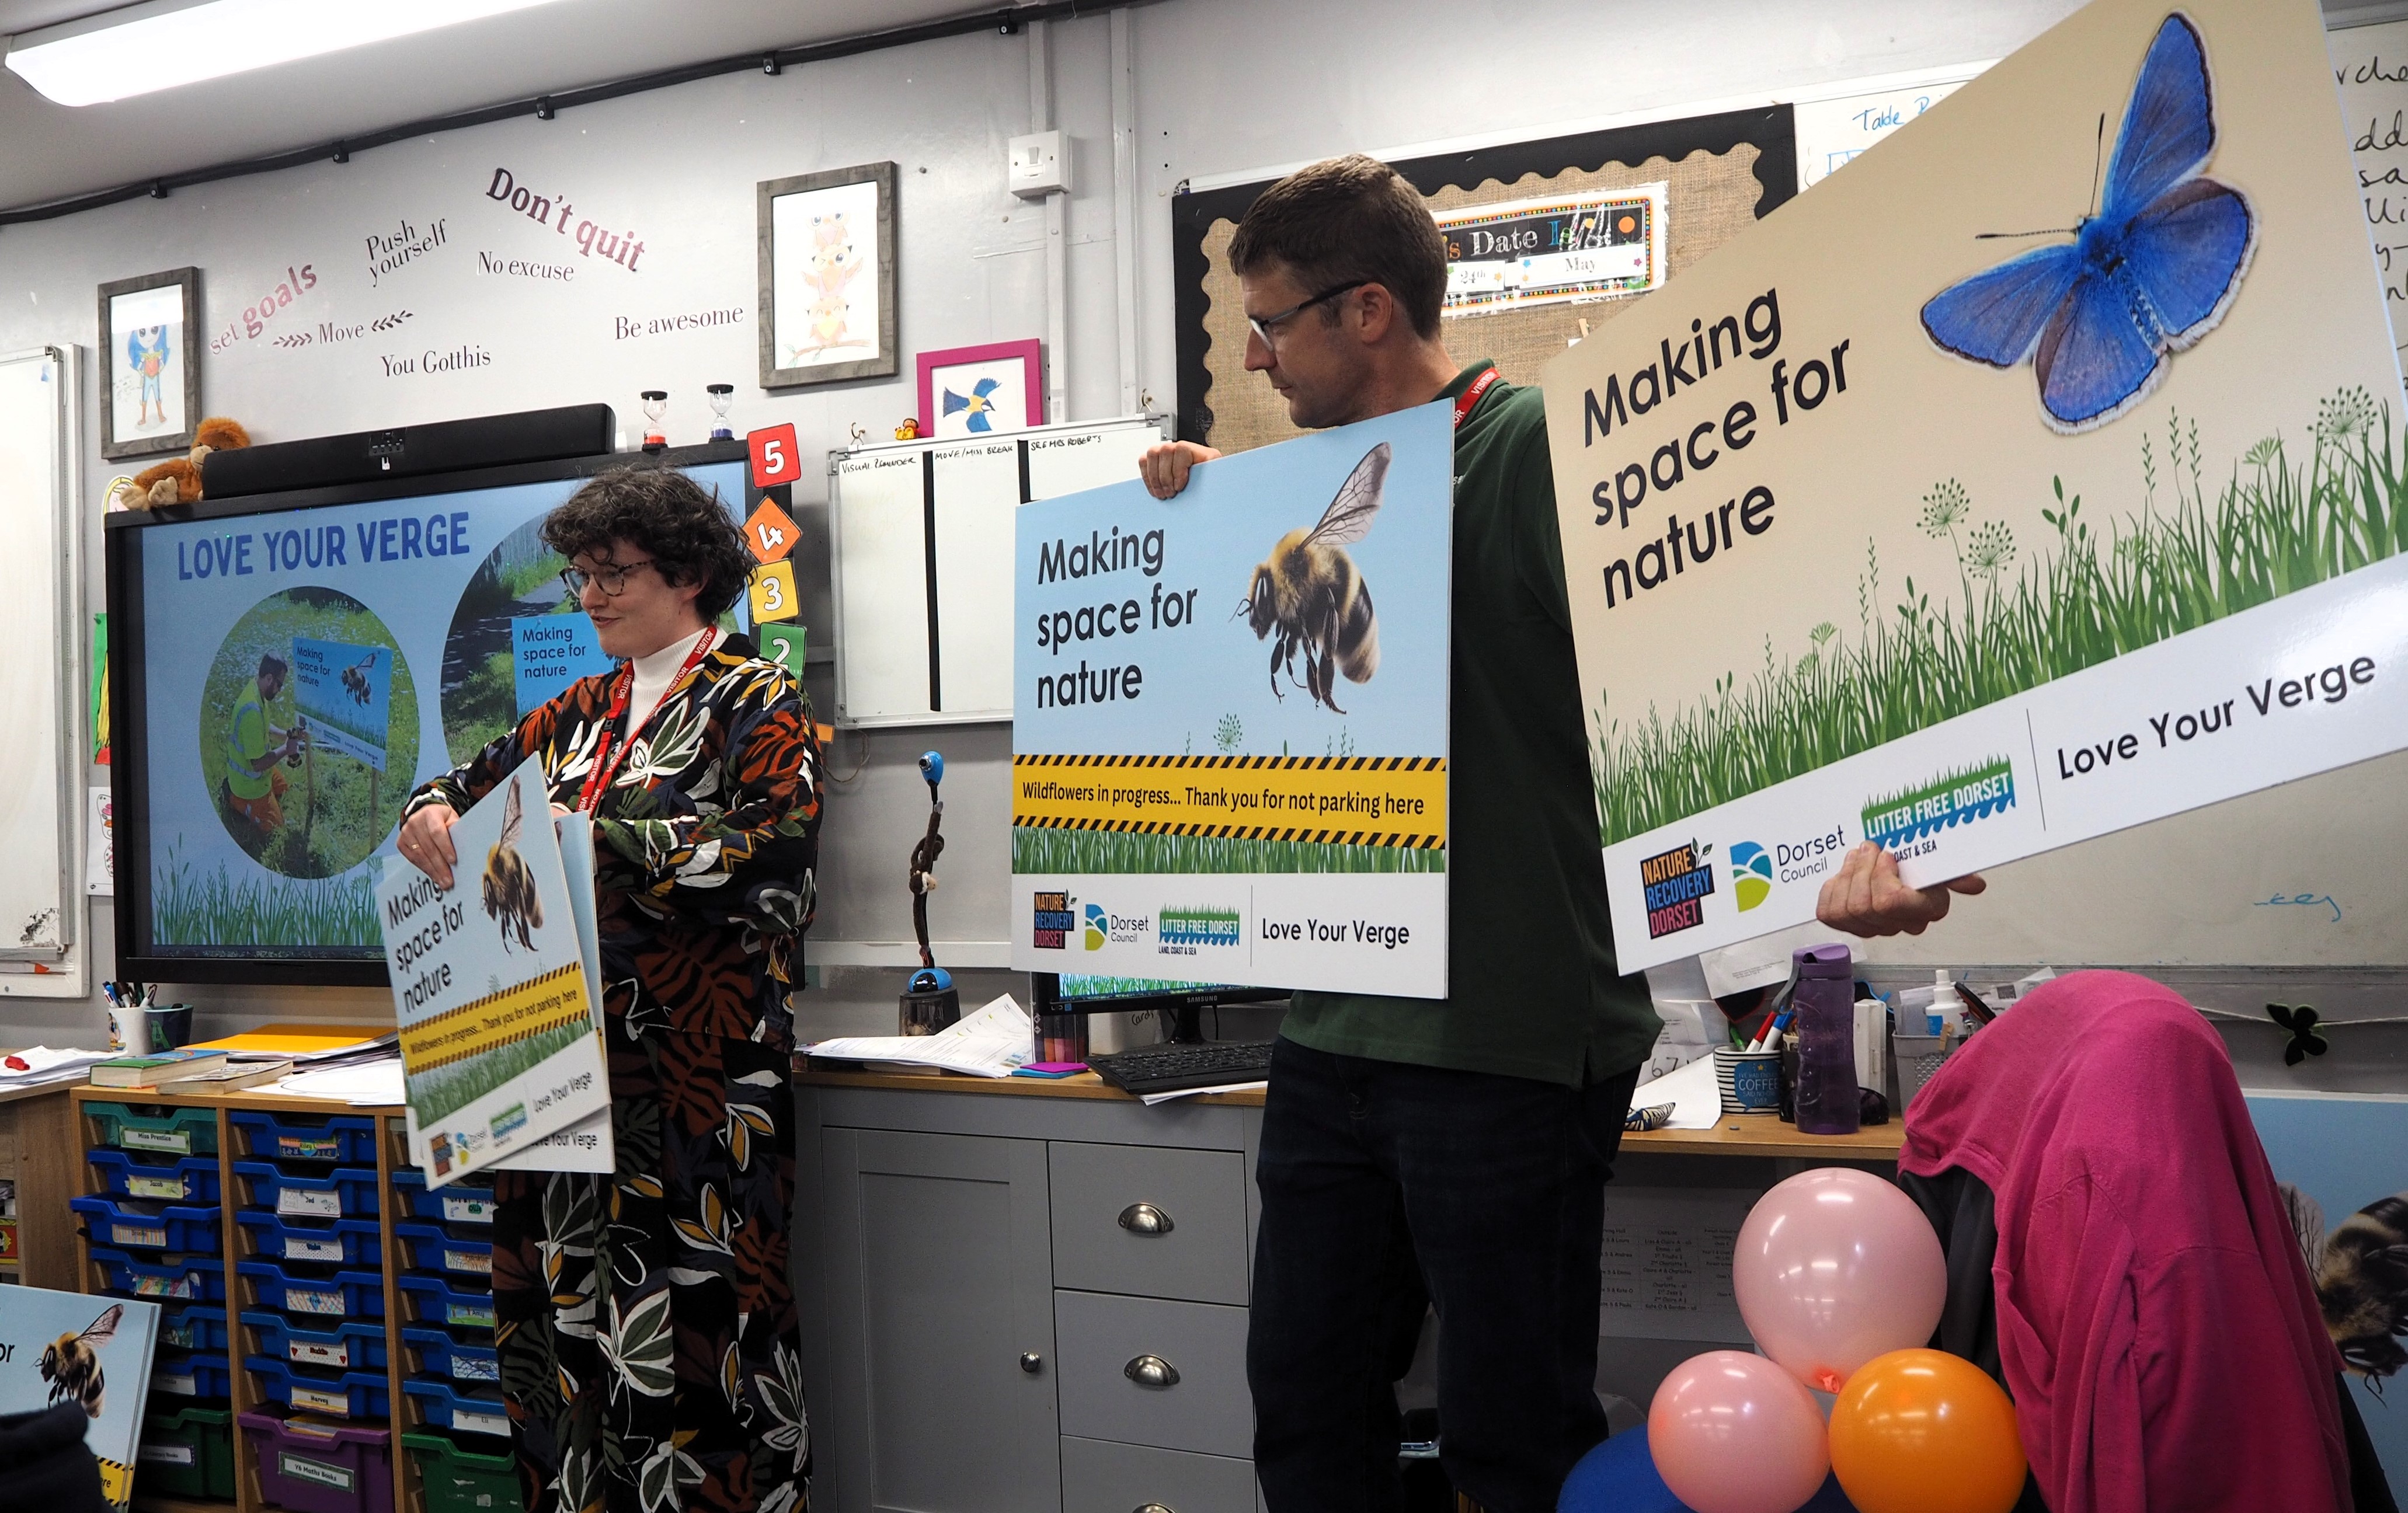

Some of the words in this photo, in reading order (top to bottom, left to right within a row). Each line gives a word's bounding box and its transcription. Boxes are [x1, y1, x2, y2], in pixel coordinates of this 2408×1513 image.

[1852, 104, 1905, 131] Table
[486, 168, 573, 234] Don't
[576, 219, 645, 272] quit
[365, 219, 416, 260] Push
[369, 219, 447, 287] yourself
[1469, 226, 1538, 256] Date
[478, 251, 503, 275] No
[509, 259, 574, 281] excuse
[1565, 257, 1596, 273] May
[210, 323, 238, 355] set
[242, 263, 317, 339] goals
[319, 322, 364, 344] Move
[614, 316, 642, 340] Be
[649, 306, 744, 335] awesome
[381, 354, 415, 378] You
[1584, 287, 1782, 448] Making
[1471, 372, 1495, 395] VISITO
[1592, 400, 1757, 529] space
[1771, 339, 1850, 426] for
[764, 441, 785, 475] 5
[987, 445, 1013, 455] BREAK
[842, 462, 871, 473] VISUAL
[178, 535, 253, 580] LOVE
[264, 525, 346, 572] YOUR
[357, 512, 470, 563] VERGE
[758, 522, 784, 552] 4
[1603, 485, 1775, 609] nature
[1038, 525, 1164, 585] Making
[763, 576, 784, 611] 3
[1037, 598, 1140, 655] space
[1151, 583, 1198, 630] for
[523, 627, 573, 644] Making
[694, 630, 714, 655] VISITOR
[297, 646, 323, 663] Making
[523, 647, 565, 663] space
[569, 644, 586, 659] for
[770, 636, 791, 669] 2
[297, 661, 319, 672] space
[320, 664, 331, 676] for
[297, 674, 319, 687] nature
[524, 663, 567, 679] nature
[667, 666, 689, 693] VISITOR
[617, 674, 633, 700] VISITOR
[1037, 660, 1143, 709] nature
[2057, 732, 2139, 780] Love
[2149, 699, 2235, 748] Your
[2246, 656, 2376, 717] Verge
[587, 753, 603, 782] VISITOR
[606, 744, 628, 772] VISITOR
[1022, 782, 1094, 802] Wildflowers
[1097, 782, 1109, 801] in
[1112, 786, 1181, 808] progress...
[1185, 787, 1228, 807] Thank
[1231, 794, 1259, 812] you
[1262, 789, 1285, 809] for
[1289, 792, 1315, 811] not
[1319, 790, 1381, 818] parking
[1386, 794, 1424, 815] here
[1866, 806, 1913, 839] LITTER
[1915, 793, 1951, 824] FREE
[1953, 771, 2010, 811] DORSET
[1777, 824, 1846, 868] Dorset
[1894, 848, 1913, 863] OAST
[1914, 845, 1920, 856] &
[1922, 839, 1937, 853] SEA
[1642, 846, 1693, 886] NATURE
[1780, 857, 1829, 884] Council
[387, 875, 444, 930] Making
[1035, 893, 1064, 911] NATURE
[1645, 867, 1712, 911] RECOVERY
[1035, 911, 1074, 930] RECOVERY
[1111, 914, 1149, 932] Dorset
[1161, 918, 1186, 933] LITTER
[1188, 919, 1207, 935] FREE
[1209, 920, 1238, 935] DORSET
[1650, 899, 1698, 937] DORSET
[396, 919, 441, 975] space
[442, 901, 464, 936] for
[1035, 931, 1064, 947] DORSET
[1111, 932, 1138, 943] Council
[1262, 918, 1301, 942] Love
[1307, 919, 1347, 943] Your
[1352, 920, 1410, 950] Verge
[1171, 946, 1184, 955] COAST
[1188, 947, 1196, 956] SEA
[403, 963, 452, 1014] nature
[562, 988, 577, 1003] here
[152, 1019, 170, 1050] A
[569, 1072, 593, 1092] Verge
[1738, 1078, 1779, 1091] COFFEE
[138, 1132, 149, 1140] Miss
[151, 1133, 172, 1142] Prentice
[572, 1131, 597, 1150] Verge
[149, 1180, 163, 1188] Jacob
[472, 1310, 485, 1318] Amy
[0, 1343, 15, 1362] or
[311, 1395, 329, 1406] Harvey
[100, 1477, 112, 1487] re
[294, 1463, 302, 1472] Y6
[304, 1466, 320, 1477] Maths
[321, 1469, 337, 1481] Books
